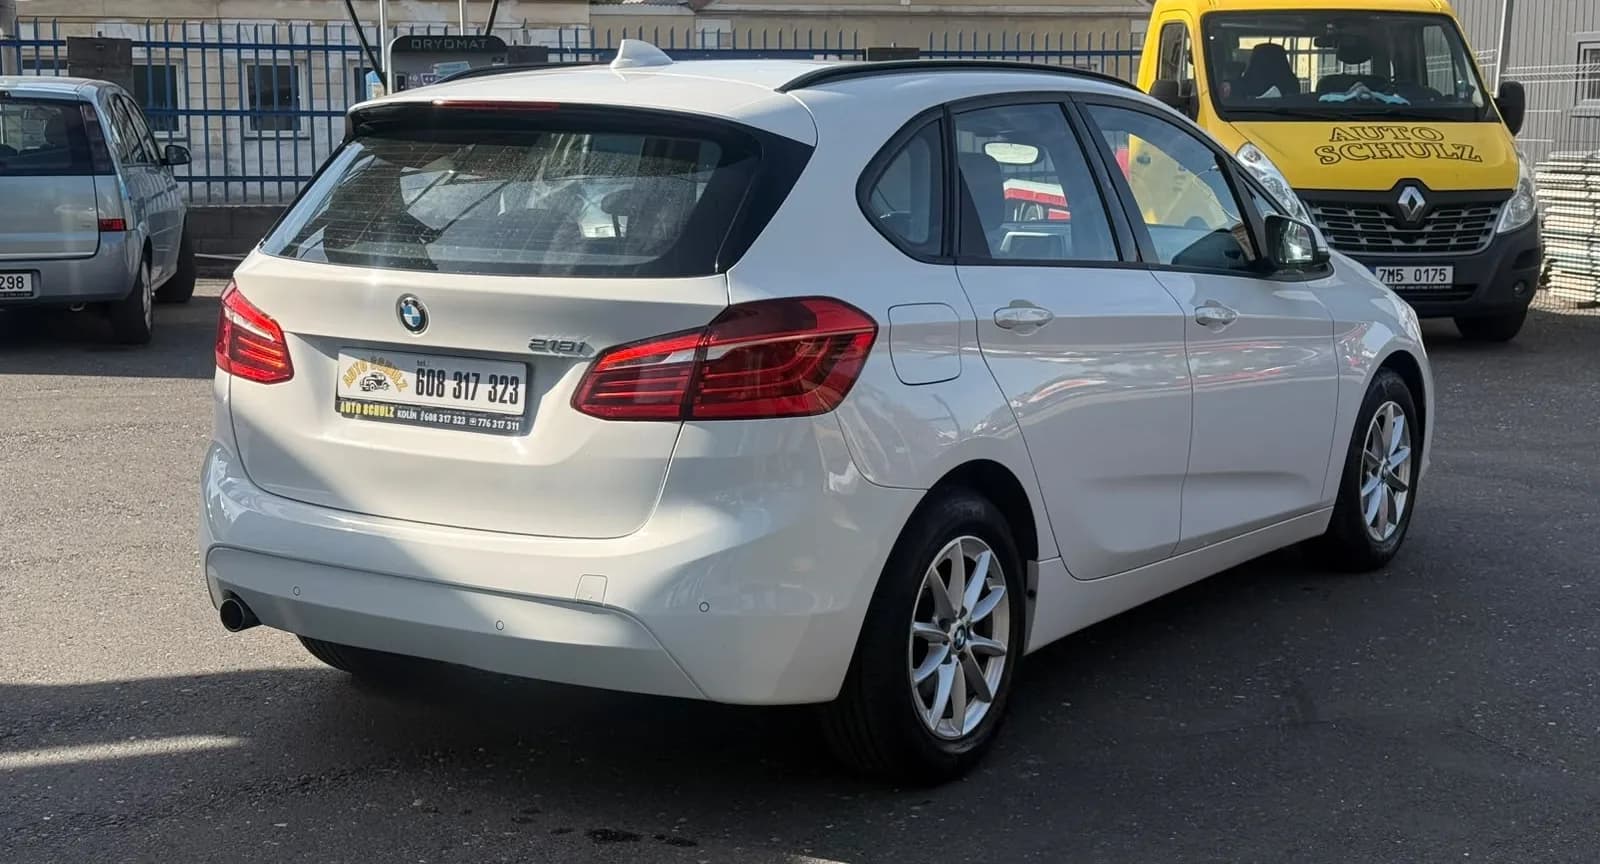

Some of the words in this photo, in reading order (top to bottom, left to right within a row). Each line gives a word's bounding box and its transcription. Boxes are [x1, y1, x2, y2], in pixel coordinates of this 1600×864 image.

[411, 39, 488, 49] DRYOMAT
[1329, 126, 1444, 142] AUTO
[1314, 142, 1483, 165] SCHULZ
[0, 276, 24, 289] 298
[1379, 268, 1404, 282] 7M5
[1414, 268, 1447, 282] 0175
[415, 367, 446, 398] 608
[452, 371, 481, 401] 317
[488, 374, 520, 405] 323
[340, 401, 362, 414] AUTO
[363, 403, 395, 418] SCHULZ
[424, 411, 437, 422] 608
[438, 413, 452, 424] 317
[453, 415, 466, 425] 323
[478, 418, 491, 428] 776
[492, 419, 505, 430] 317
[506, 421, 520, 431] 311
